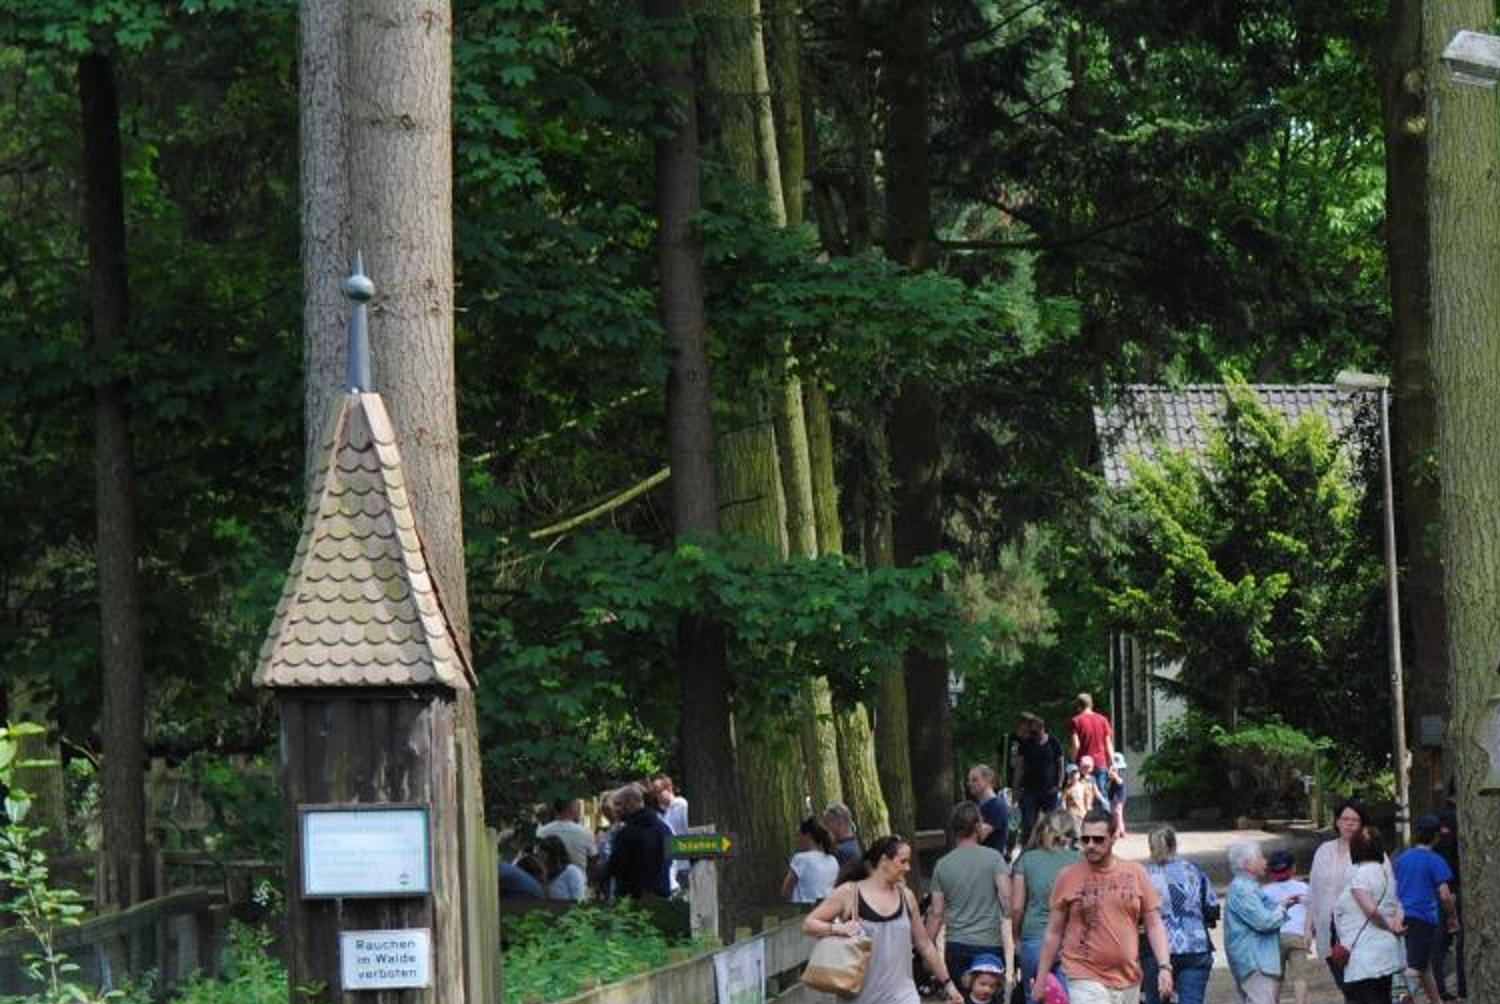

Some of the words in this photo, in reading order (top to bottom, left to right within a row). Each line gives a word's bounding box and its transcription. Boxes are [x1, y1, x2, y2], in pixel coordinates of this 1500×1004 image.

[355, 939, 416, 951] Rauchen
[358, 956, 371, 965] im
[376, 953, 416, 964] Walde
[358, 968, 417, 979] verboten
